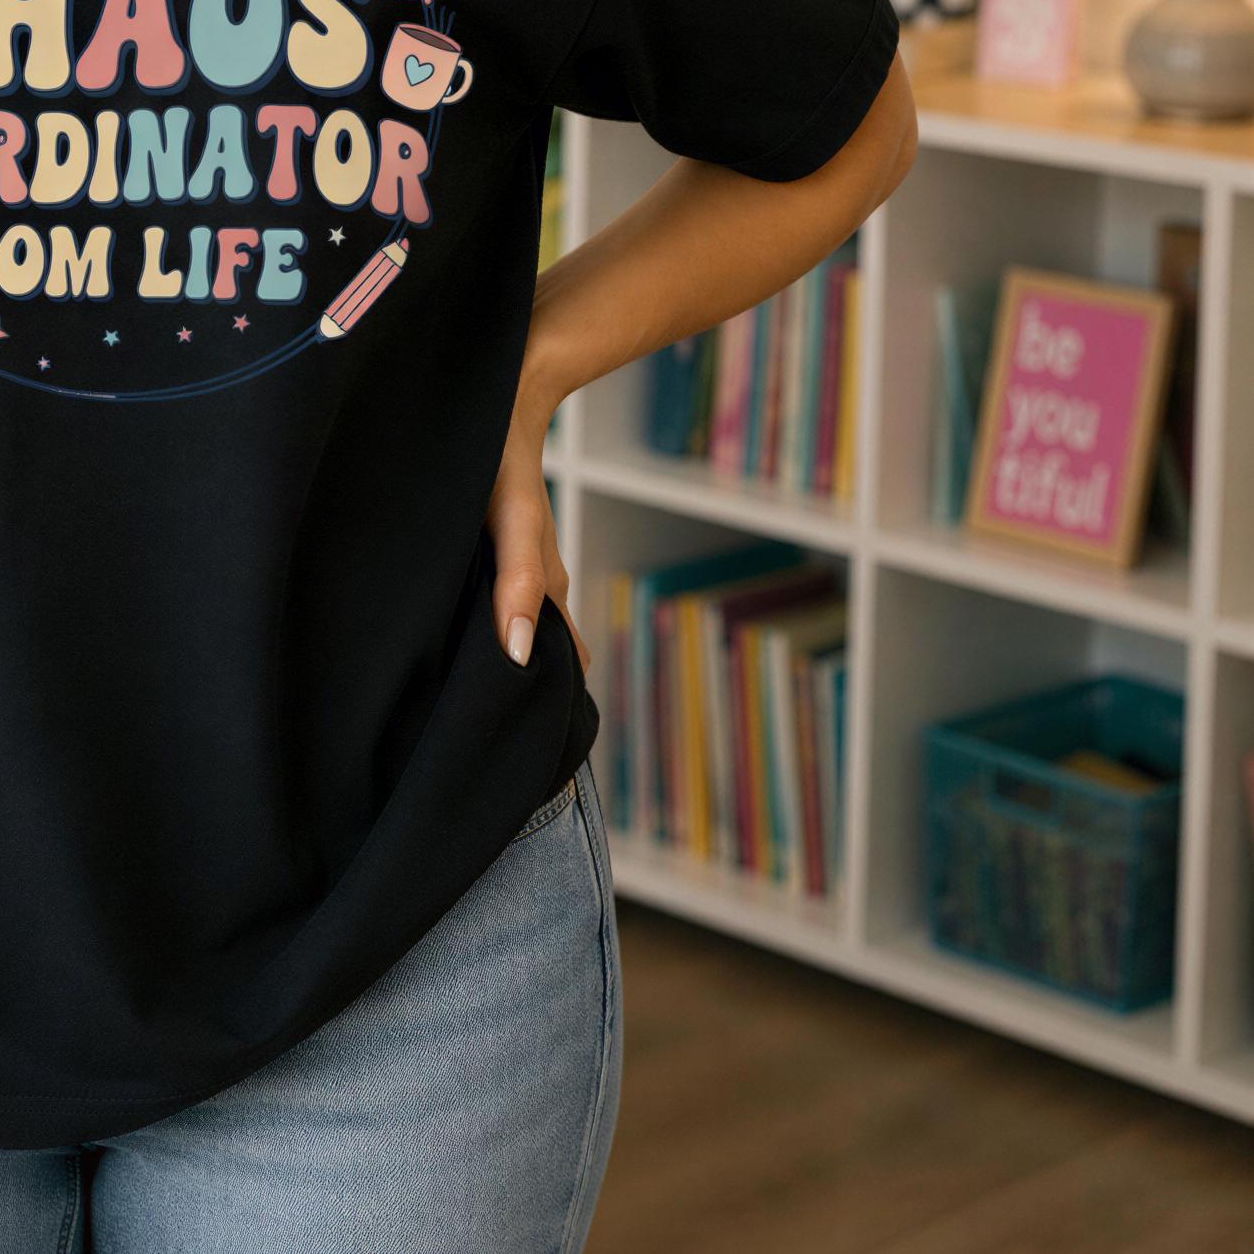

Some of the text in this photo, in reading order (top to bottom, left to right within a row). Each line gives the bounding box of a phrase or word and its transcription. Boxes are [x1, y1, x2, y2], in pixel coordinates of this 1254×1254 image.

[137, 224, 308, 303] LIFE
[1016, 298, 1086, 381] be
[1005, 386, 1103, 454] you
